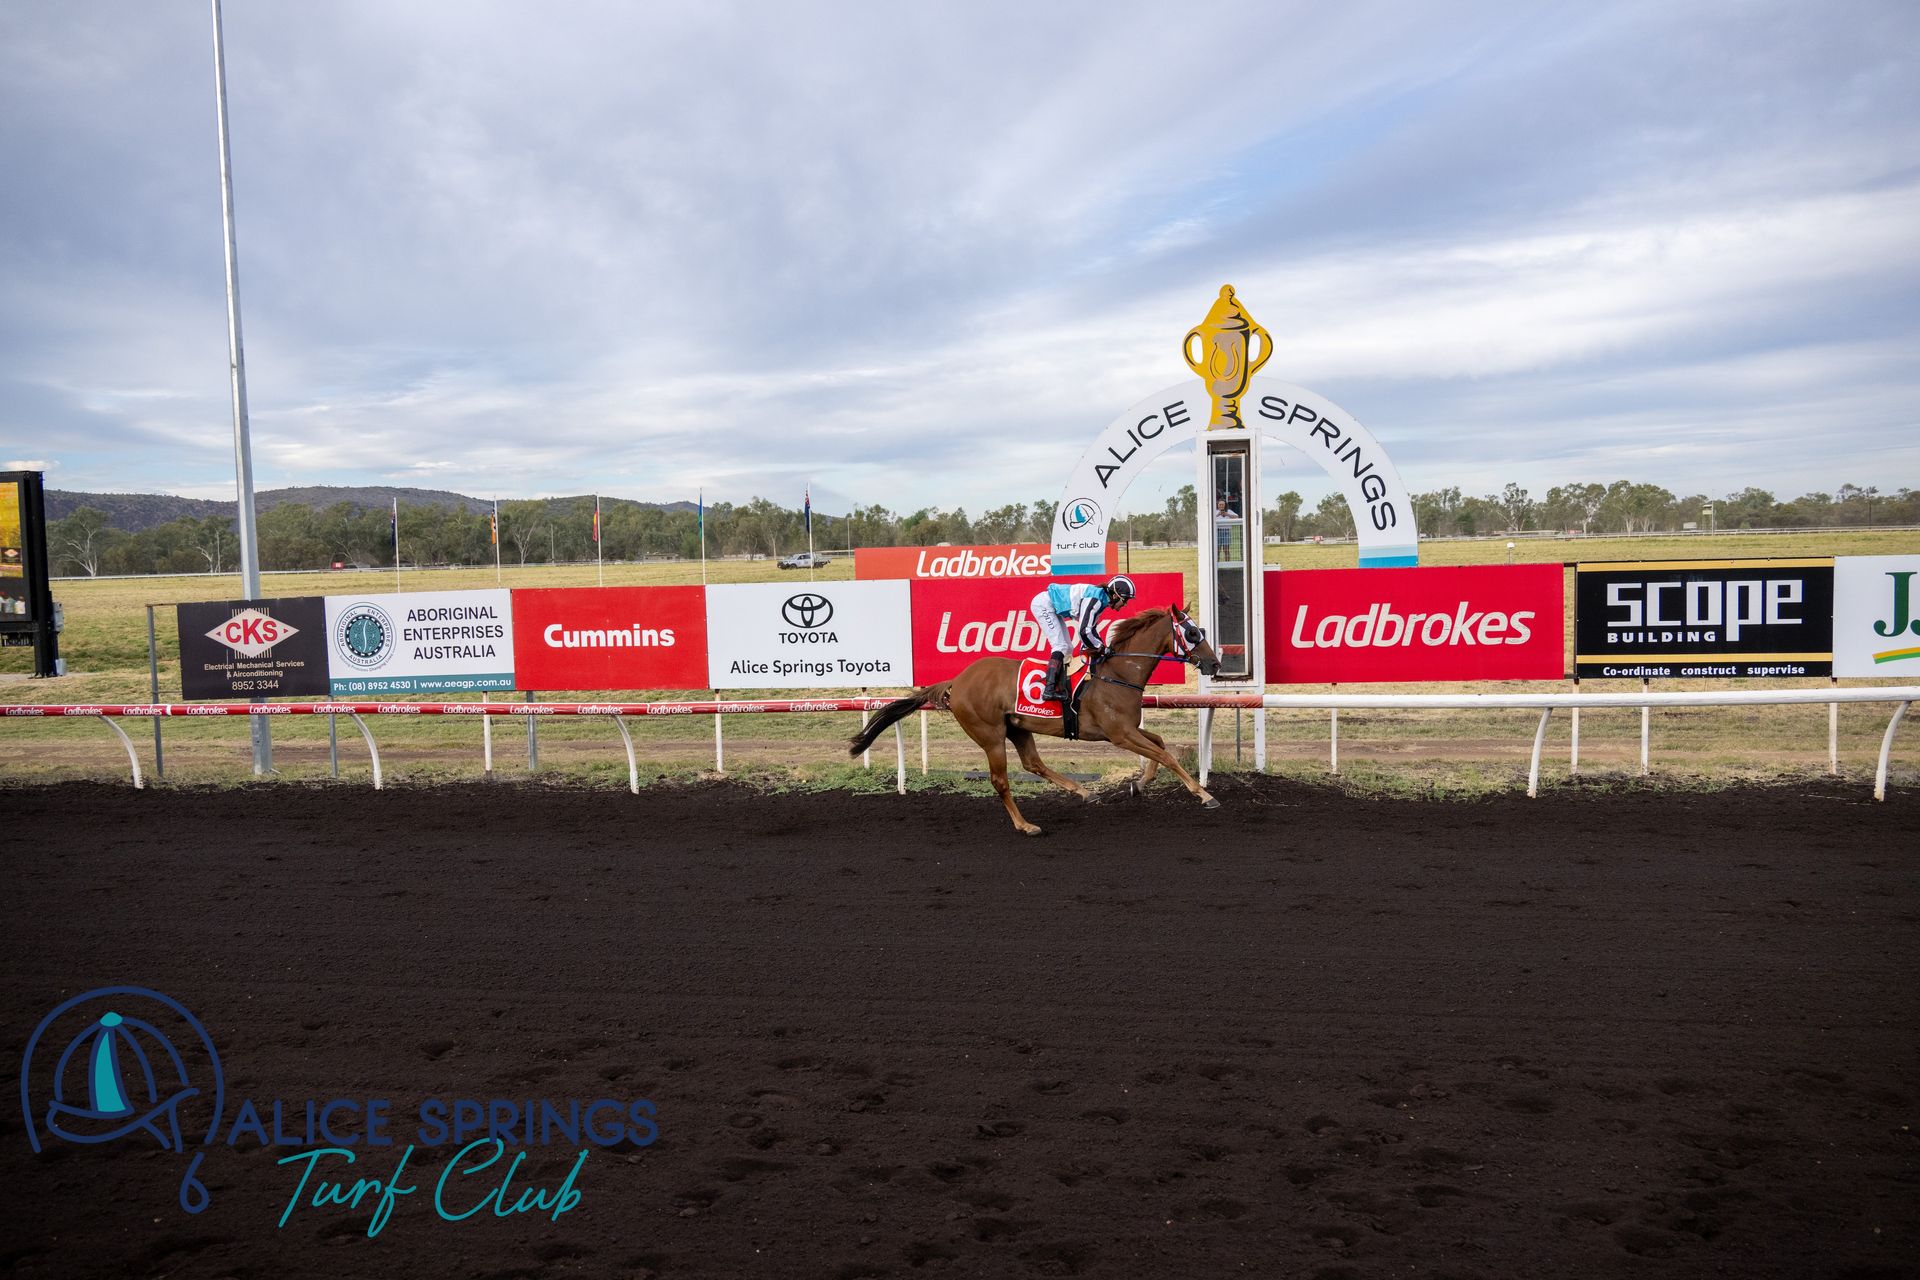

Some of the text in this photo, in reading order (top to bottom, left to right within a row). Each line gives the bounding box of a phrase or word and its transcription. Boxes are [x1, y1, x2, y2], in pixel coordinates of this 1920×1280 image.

[1094, 396, 1397, 531] ALICE SPRINGS
[1056, 541, 1100, 550] turf club
[916, 549, 1051, 578] Ladbrokes
[1873, 571, 1920, 638] J
[407, 606, 498, 622] ABORIGINAL
[339, 608, 391, 648] ABORIGINAL ENTERPRISES
[1291, 601, 1536, 649] Ladbrokes
[225, 618, 278, 646] CKS
[404, 625, 504, 641] ENTERPRISES
[543, 623, 676, 648] Cummins
[1607, 631, 1717, 643] BUILDING
[778, 632, 839, 644] TOYOTA
[413, 645, 496, 660] AUSTRALIA
[349, 654, 383, 665] AUSTRALIA
[204, 663, 235, 671] Electrical
[275, 660, 305, 668] Services
[730, 659, 891, 677] Alice Springs Toyota
[1602, 665, 1805, 676] Co-ordinate construct supervise
[232, 670, 284, 678] Airconditioning
[232, 680, 280, 691] 8952 3344
[333, 679, 512, 692] Ph: (08) 8952 4530 www.aeagp.com.au
[1021, 669, 1047, 705] 6
[63, 706, 103, 716] Ladbrokes
[122, 706, 162, 716] Ladbrokes
[186, 705, 228, 715] Ladbrokes
[249, 705, 292, 714] Ladbrokes
[313, 704, 356, 714] Ladbrokes
[377, 704, 421, 714] Ladbrokes
[443, 704, 487, 714] Ladbrokes
[509, 705, 555, 715] Ladbrokes
[577, 705, 624, 715] Ladbrokes
[646, 704, 693, 715] Ladbrokes
[717, 703, 765, 713] Ladbrokes
[789, 702, 838, 712] Ladbrokes
[1017, 703, 1055, 716] Ladbrokes
